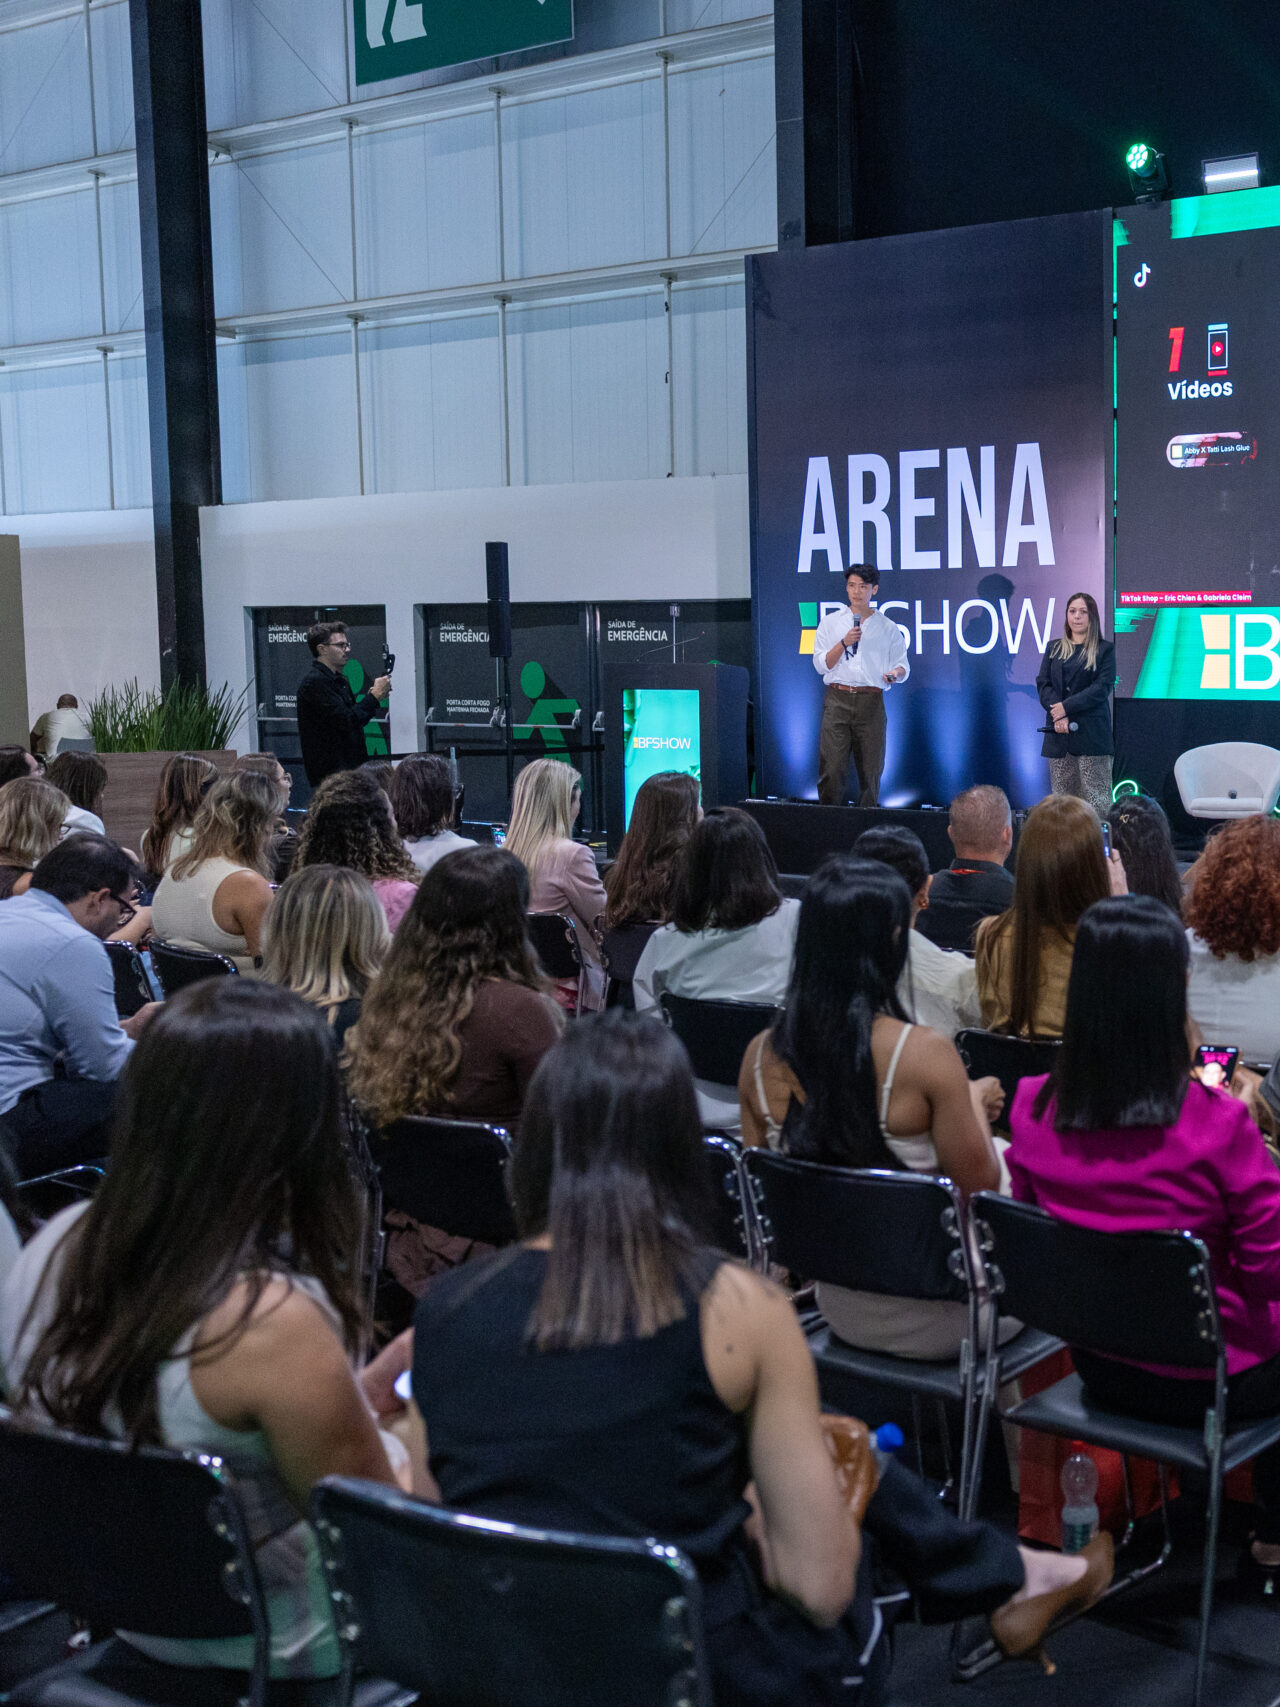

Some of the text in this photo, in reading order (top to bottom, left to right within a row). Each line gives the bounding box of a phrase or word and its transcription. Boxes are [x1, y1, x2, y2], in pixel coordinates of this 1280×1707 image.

[1168, 326, 1185, 372] 1
[1168, 380, 1233, 400] Vídeos
[1184, 447, 1200, 455] Abby
[797, 442, 1055, 573] ARENA
[1142, 595, 1158, 603] Shop
[440, 621, 456, 630] SAÍDA
[608, 619, 626, 628] SAÍDA
[820, 598, 1056, 654] SHOW
[268, 630, 307, 643] EMERGÊNC
[608, 627, 668, 641] EMERGÊNCIA
[638, 737, 691, 749] BFSHOW
